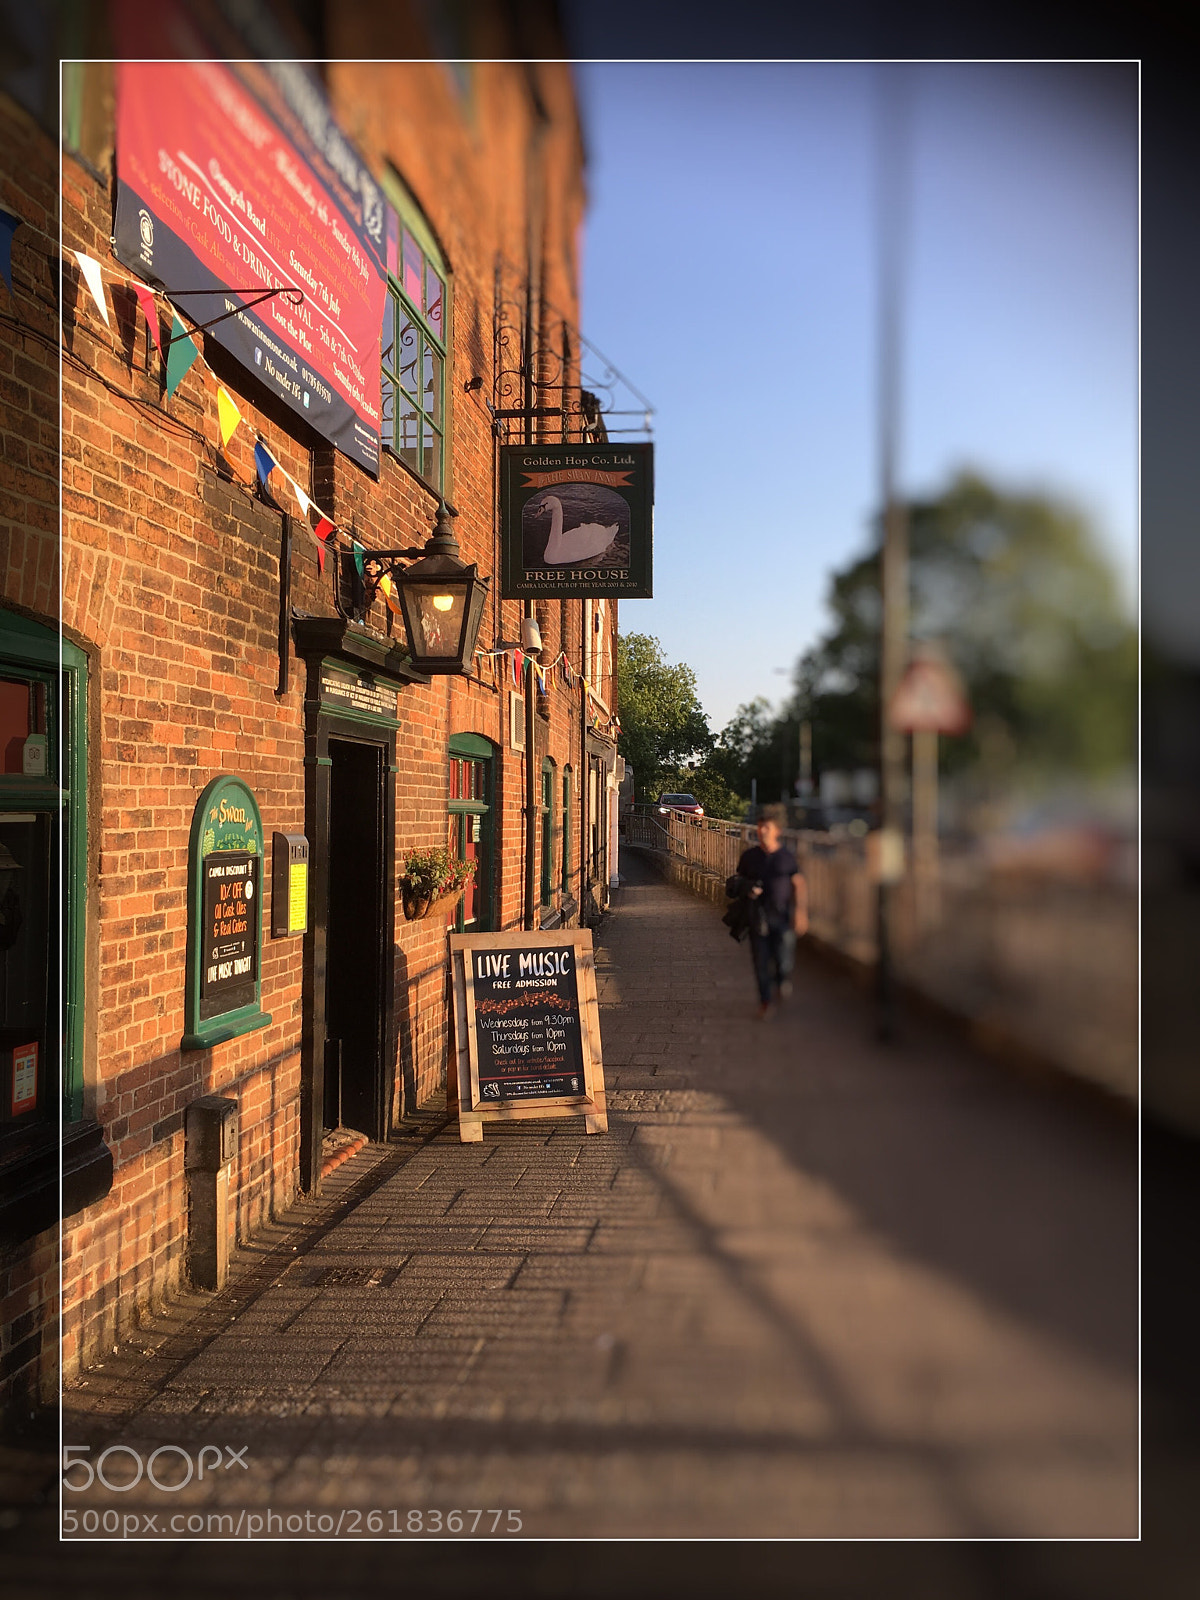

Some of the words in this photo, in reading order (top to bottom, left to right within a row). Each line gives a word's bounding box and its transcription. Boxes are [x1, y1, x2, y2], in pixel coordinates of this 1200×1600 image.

[203, 195, 232, 243] FOOD
[233, 235, 241, 256] &
[242, 242, 272, 289] DRINK
[247, 200, 266, 236] Band
[289, 250, 318, 295] Saturday
[318, 281, 329, 304] 7th
[328, 293, 341, 320] July
[332, 219, 351, 260] Sunday
[360, 258, 369, 285] July
[265, 356, 275, 376] No
[523, 457, 561, 466] Golden
[565, 457, 588, 466] Hop
[591, 456, 610, 464] Co.
[613, 455, 635, 464] Ltd.
[524, 571, 566, 580] FREE
[570, 570, 629, 580] HOUSE
[219, 799, 246, 824] Swan
[226, 864, 247, 876] DISCOUNT
[220, 883, 232, 900] 10%
[232, 881, 243, 899] OFF
[223, 902, 235, 918] Cask
[236, 900, 247, 916] Ales
[220, 920, 231, 936] Real
[232, 919, 247, 934] Ciders
[207, 965, 217, 983] LIVE
[218, 961, 233, 980] MUSIC
[477, 953, 511, 979] LIVE
[519, 951, 570, 977] MUSIC
[492, 980, 511, 989] FREE
[515, 978, 558, 988] ADMISSION
[480, 1017, 529, 1029] Wednesdays
[491, 1030, 529, 1042] Thursdays
[546, 1028, 565, 1040] 10pm
[492, 1044, 530, 1055] Saturdays
[547, 1041, 566, 1053] 10pm
